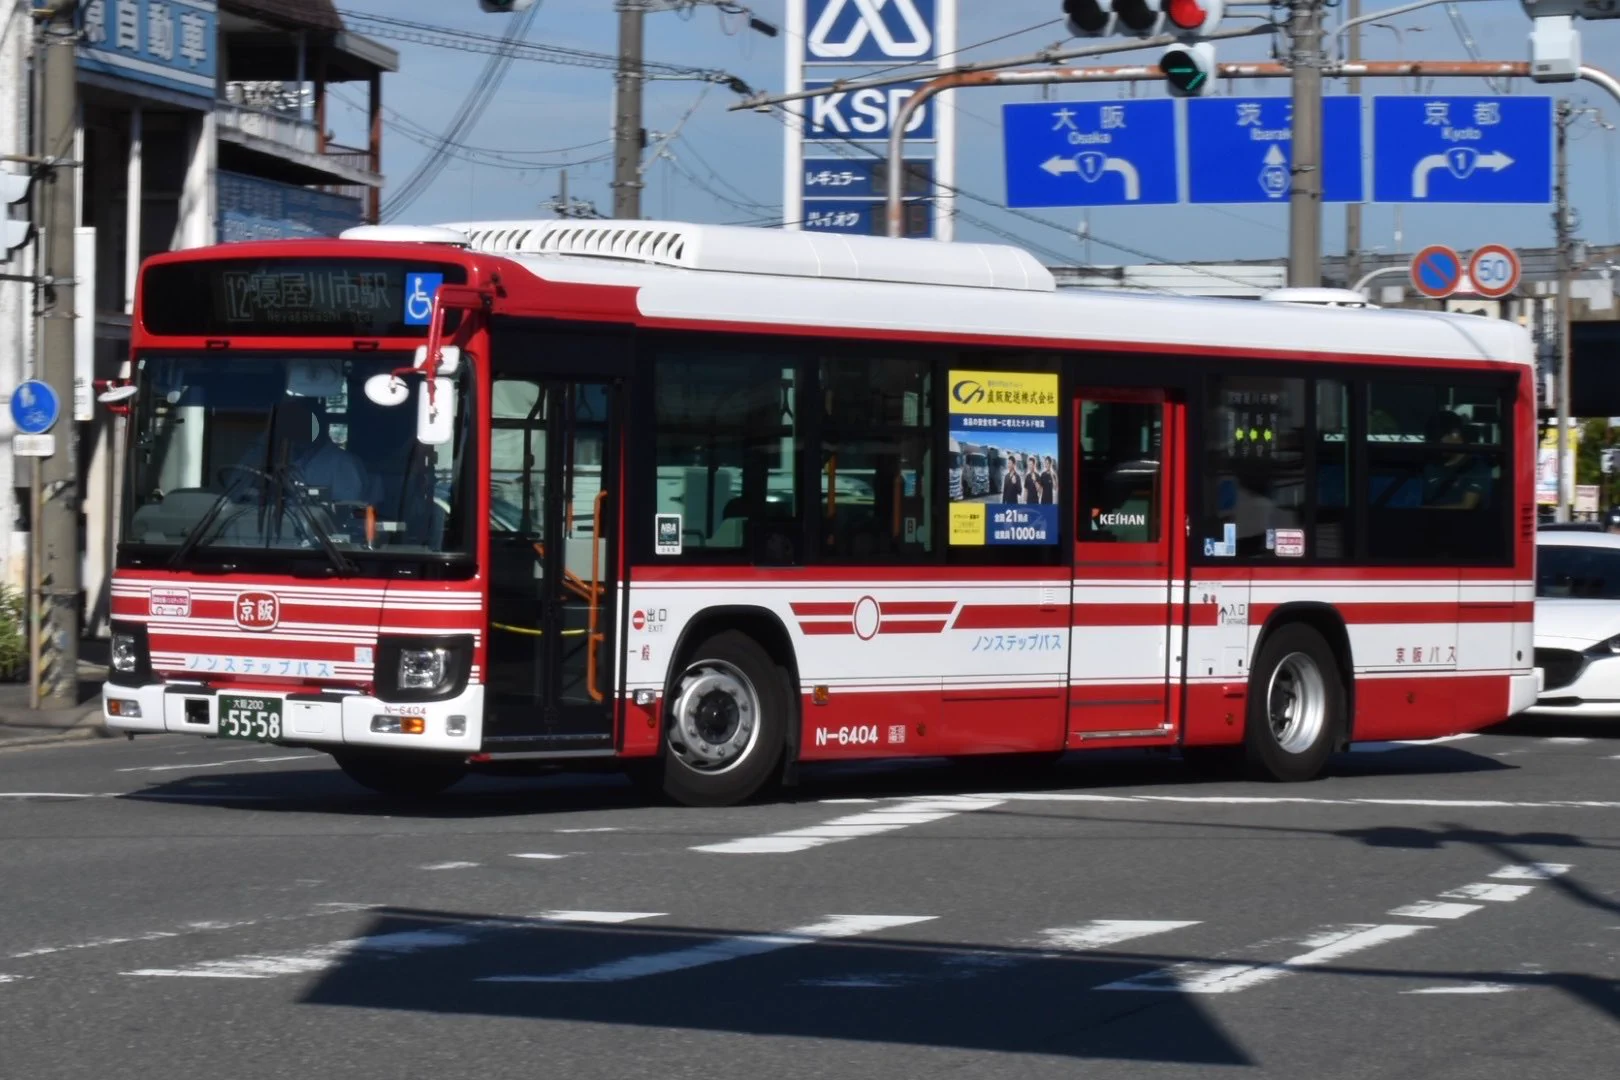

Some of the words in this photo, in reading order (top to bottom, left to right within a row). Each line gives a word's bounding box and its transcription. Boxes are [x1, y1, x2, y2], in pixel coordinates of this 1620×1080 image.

[812, 88, 926, 133] KSD
[1052, 106, 1126, 131] 大阪
[1423, 101, 1502, 125] 京都
[1067, 131, 1112, 145] Osaka
[1250, 127, 1293, 141] Ibarak
[1441, 127, 1482, 142] Kyoto
[1083, 156, 1095, 174] 1
[1454, 152, 1467, 170] 1
[805, 171, 867, 186] レギュラー
[1266, 171, 1285, 188] 19
[806, 212, 860, 227] ハイオク
[1479, 259, 1508, 281] 50
[225, 275, 251, 319] 12
[251, 270, 391, 309] 寝屋川市駅
[1100, 512, 1145, 526] KEIHAN
[239, 598, 275, 622] 京阪
[646, 607, 668, 622] 出口
[1228, 603, 1246, 617] 入口
[648, 624, 664, 633] EXIT
[971, 633, 1062, 652] ノンステップバス
[1395, 646, 1457, 664] 京阪バス
[189, 656, 331, 678] ノンステップバス
[384, 705, 427, 716] N-6404
[228, 709, 281, 739] 55-58
[815, 724, 879, 747] N-6404
